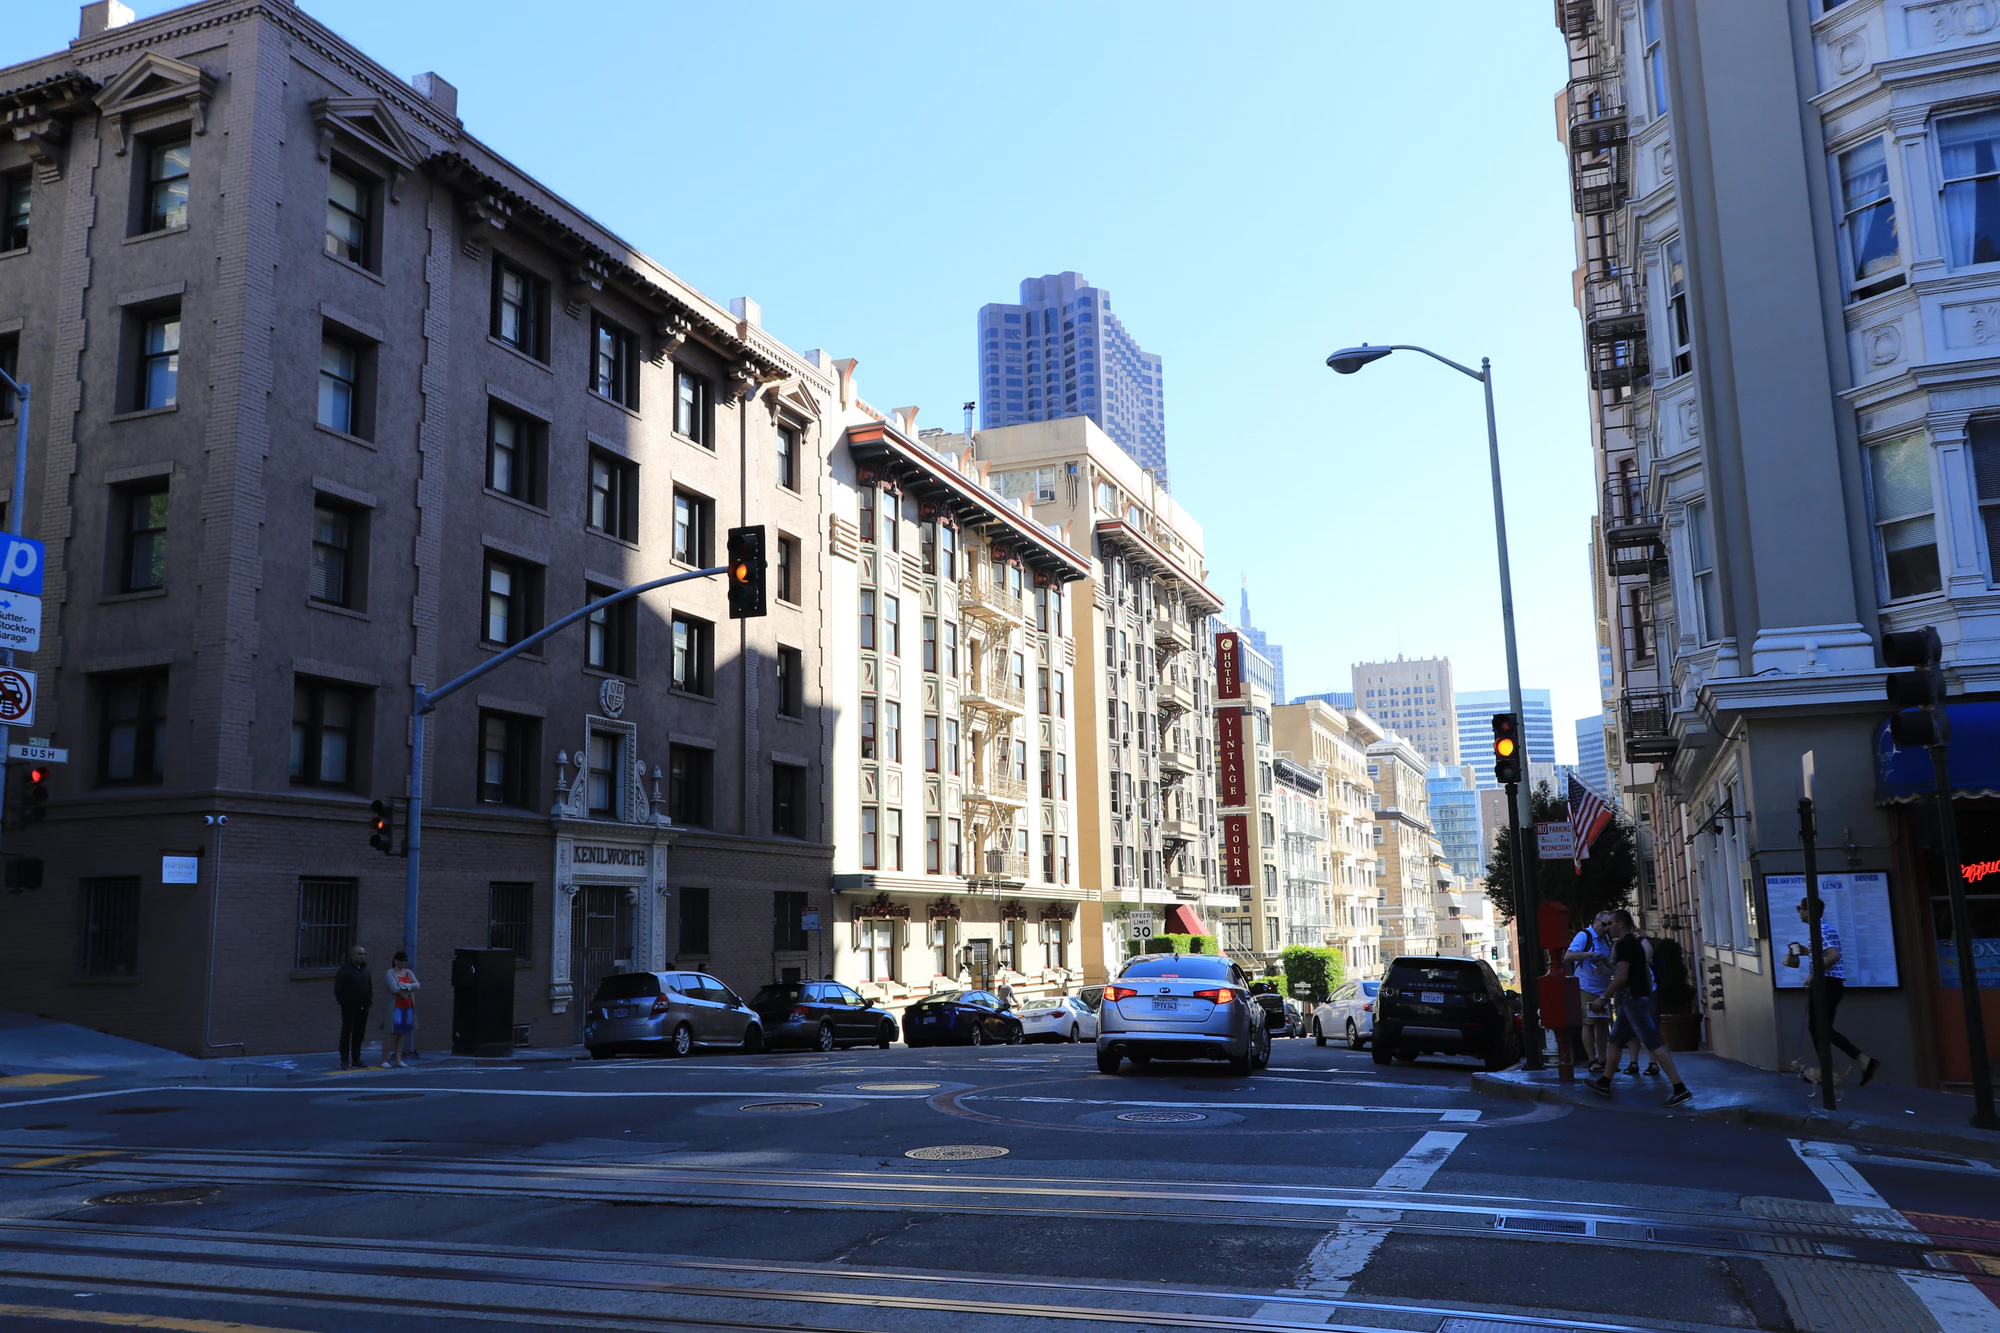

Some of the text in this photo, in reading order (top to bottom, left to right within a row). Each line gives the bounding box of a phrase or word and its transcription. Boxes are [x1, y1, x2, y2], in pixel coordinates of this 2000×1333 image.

[0, 630, 27, 643] arage
[21, 747, 55, 759] BUSH
[1223, 652, 1242, 878] HOTEL VINTAGE COURT
[1537, 824, 1571, 834] NO PARKING
[573, 846, 646, 866] KENILWORTH
[1960, 860, 2000, 883] appuc
[1767, 877, 1801, 885] BREAKFAST
[1855, 874, 1880, 882] DINNER
[1822, 882, 1843, 890] LUNCH
[1133, 926, 1151, 938] 30
